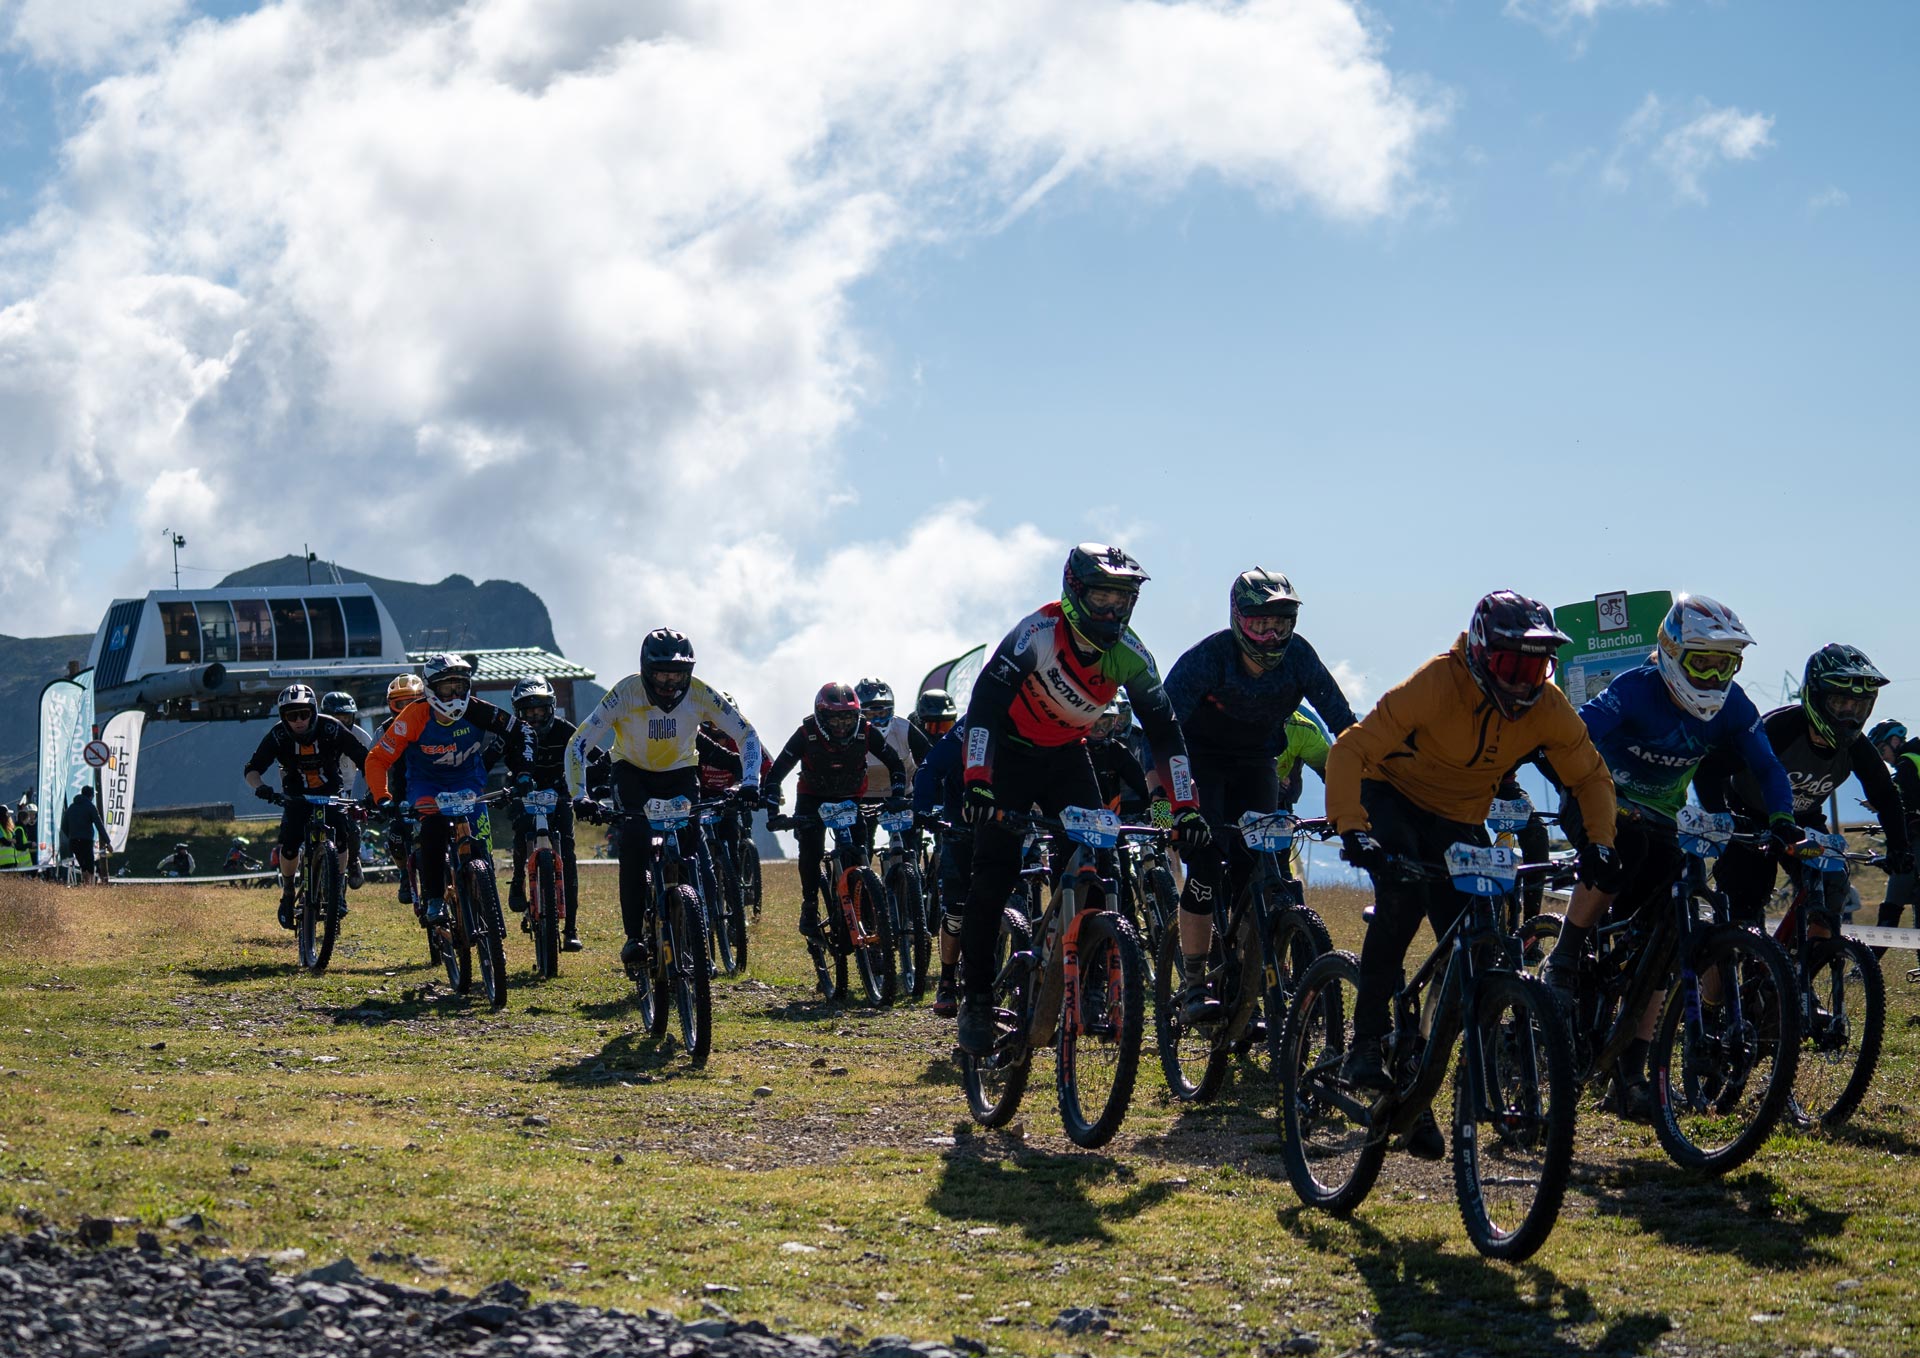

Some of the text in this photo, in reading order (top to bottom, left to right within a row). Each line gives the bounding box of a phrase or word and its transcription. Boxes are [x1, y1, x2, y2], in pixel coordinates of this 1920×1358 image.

[1588, 633, 1643, 650] Blanchon
[1047, 667, 1086, 708] SECTION
[648, 716, 677, 742] cycles
[420, 742, 457, 755] TEAM
[113, 746, 130, 826] SPORT
[655, 801, 661, 810] 3
[847, 816, 853, 824] 3
[1104, 816, 1113, 827] 3
[1682, 810, 1691, 822] 3
[1083, 831, 1102, 846] 125
[1249, 834, 1258, 845] 3
[1809, 832, 1817, 841] 3
[1496, 850, 1506, 863] 3
[1477, 877, 1493, 893] 81
